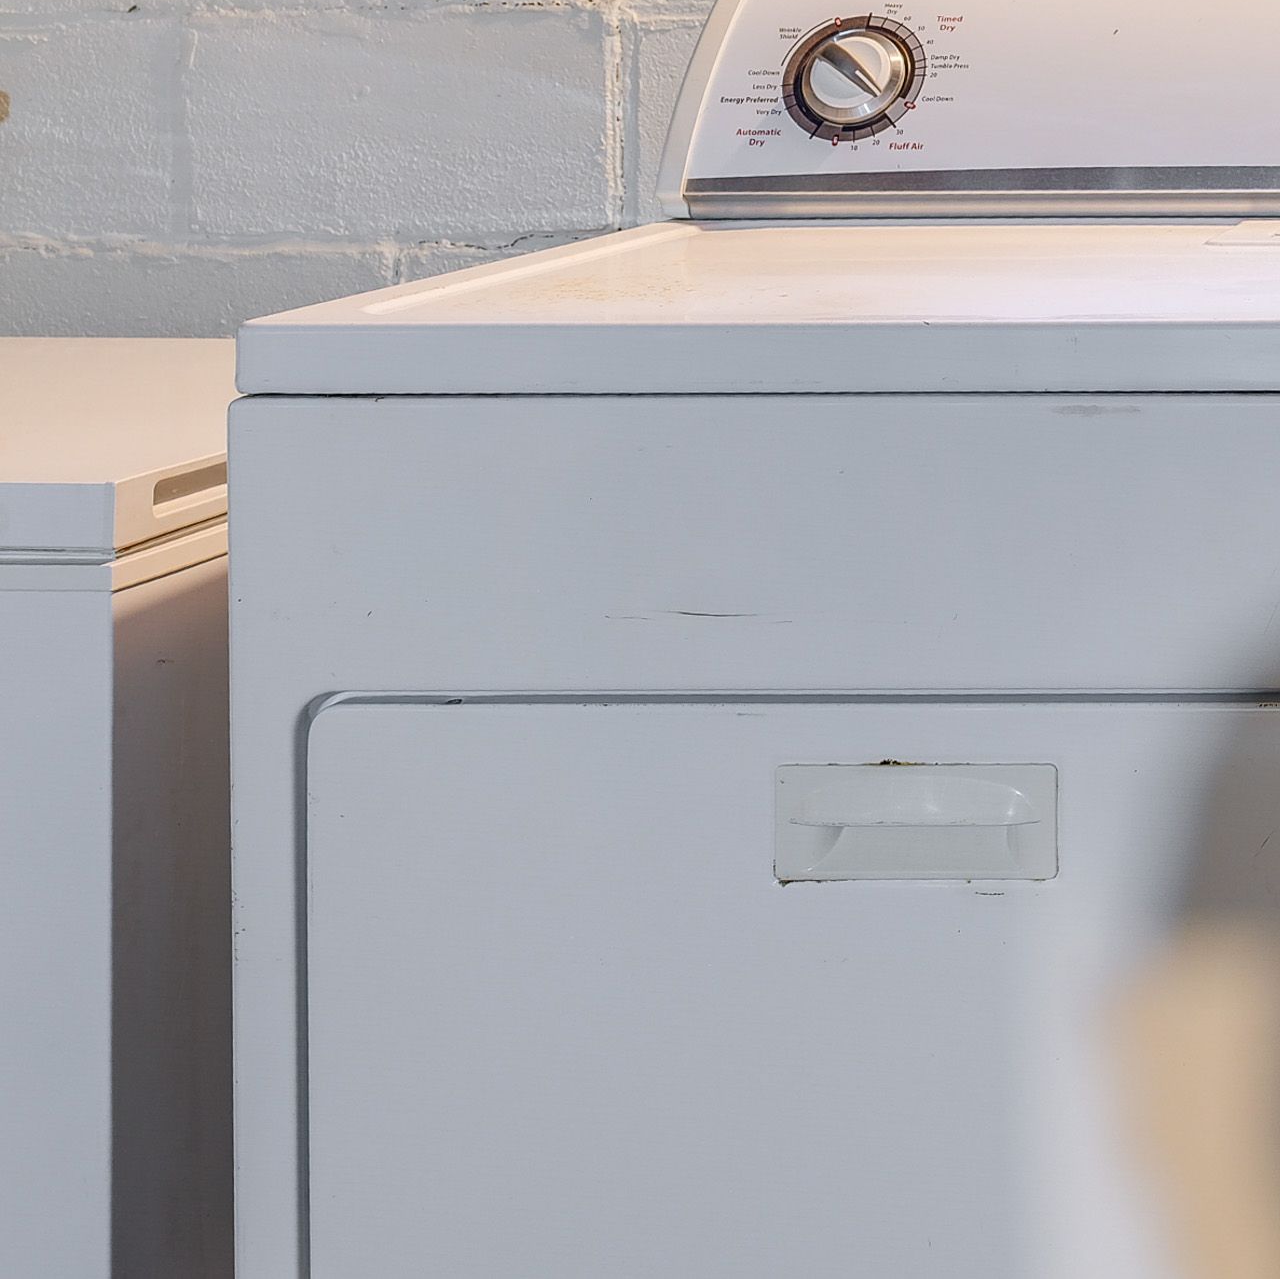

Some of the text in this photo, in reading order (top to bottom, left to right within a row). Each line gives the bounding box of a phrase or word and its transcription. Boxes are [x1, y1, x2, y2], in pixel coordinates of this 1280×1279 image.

[936, 15, 963, 23] Timed
[939, 24, 956, 33] Dry
[931, 54, 960, 62] Damp Dry
[720, 97, 744, 105] Energy
[736, 128, 782, 137] Automatic
[748, 138, 765, 147] Dry
[889, 142, 924, 151] Fluff Air
